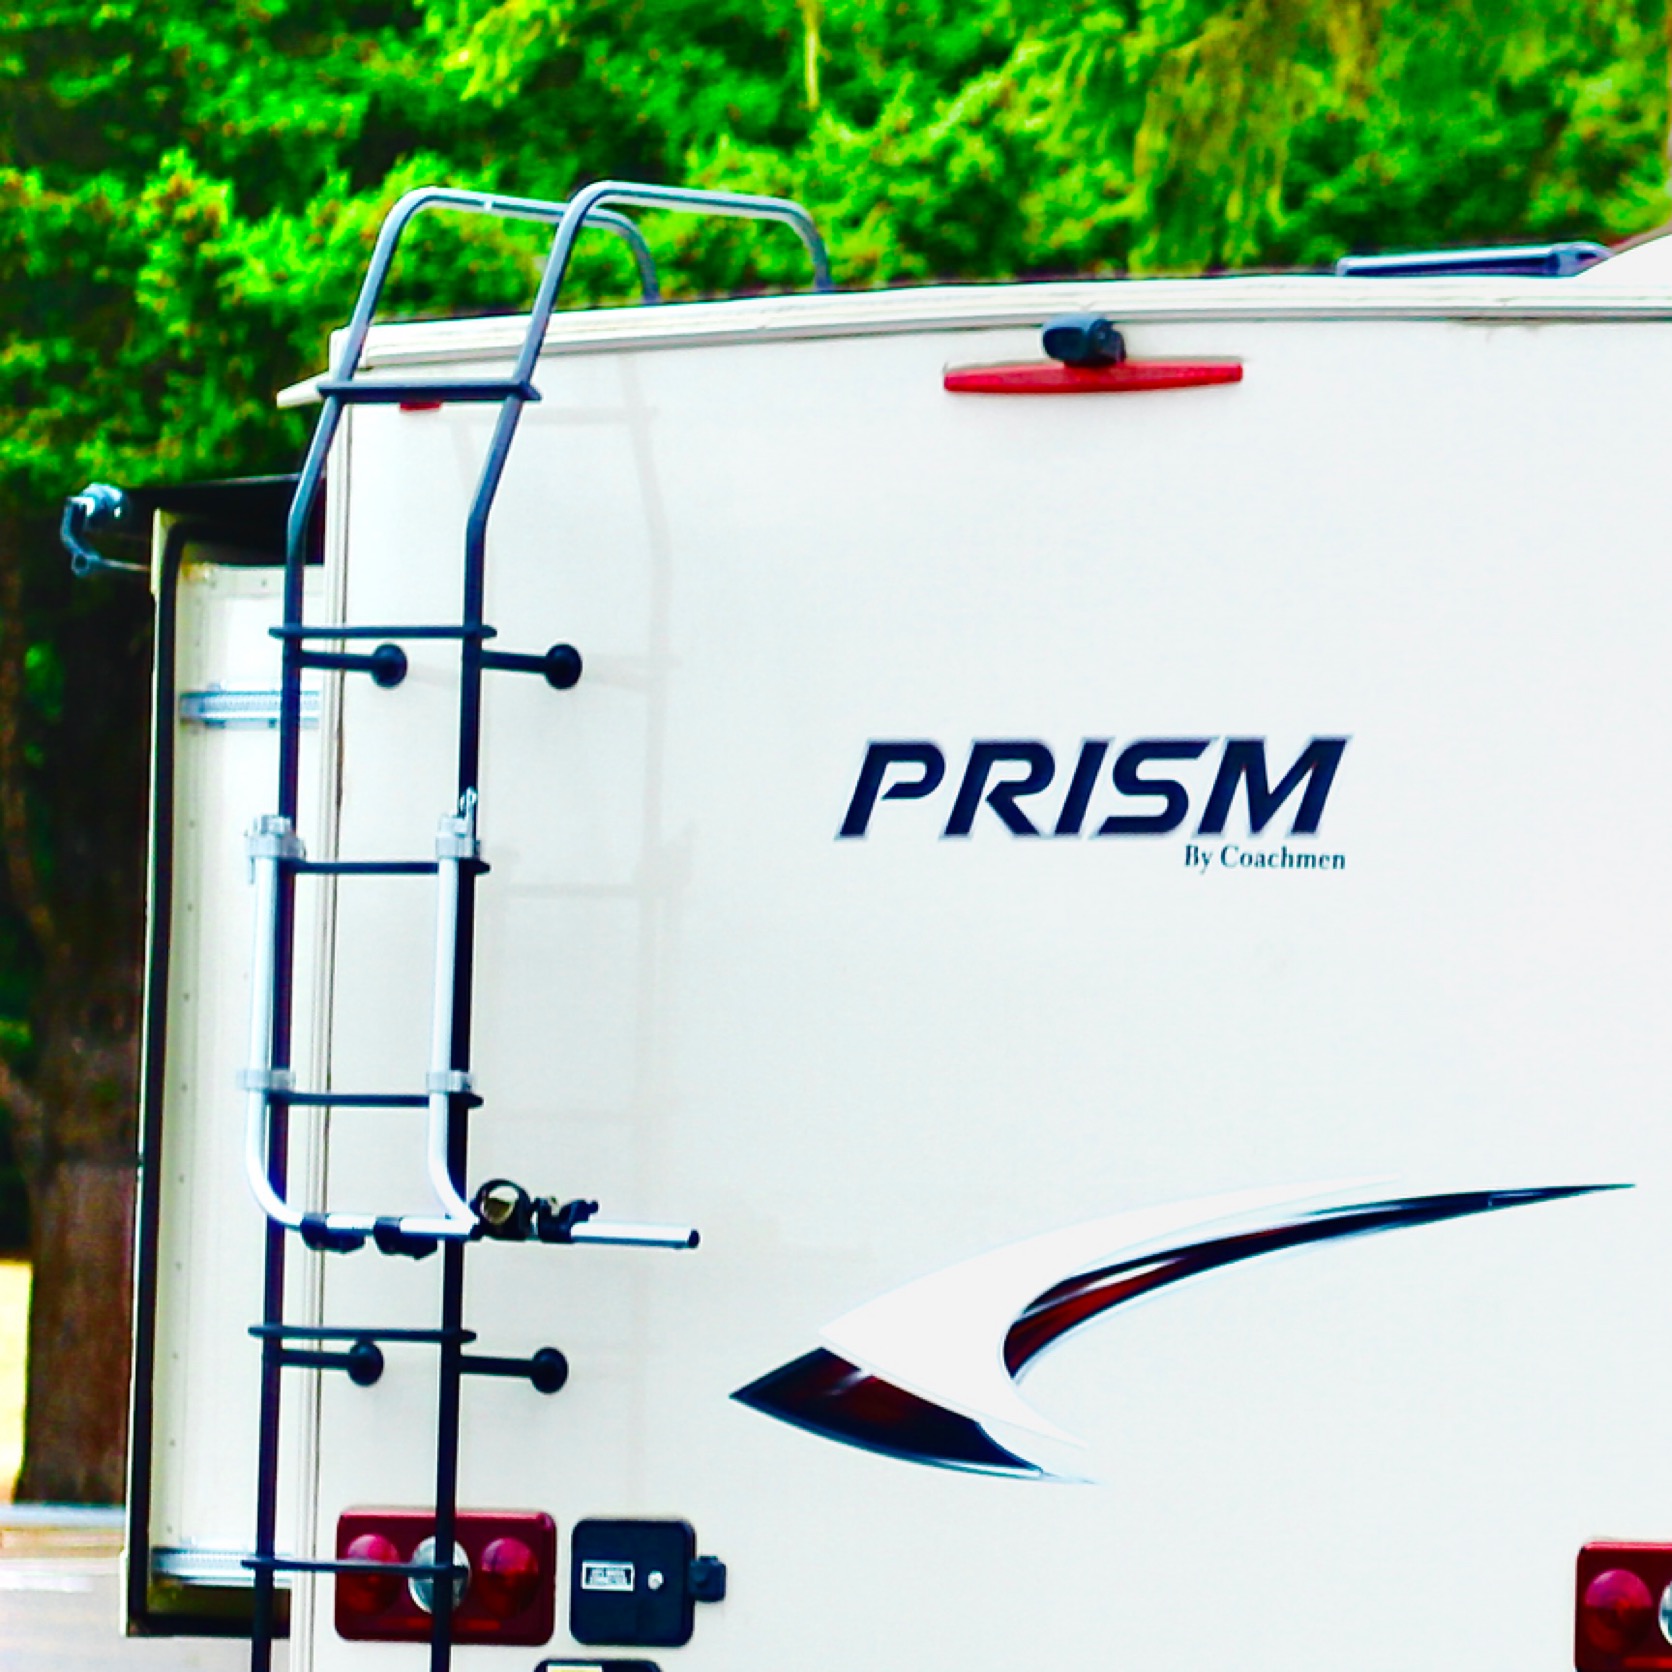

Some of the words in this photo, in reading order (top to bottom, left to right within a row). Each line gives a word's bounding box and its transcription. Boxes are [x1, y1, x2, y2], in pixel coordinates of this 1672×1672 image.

[834, 736, 1353, 840] PRISM
[1184, 844, 1212, 874] By
[1220, 845, 1346, 870] Coachmen
